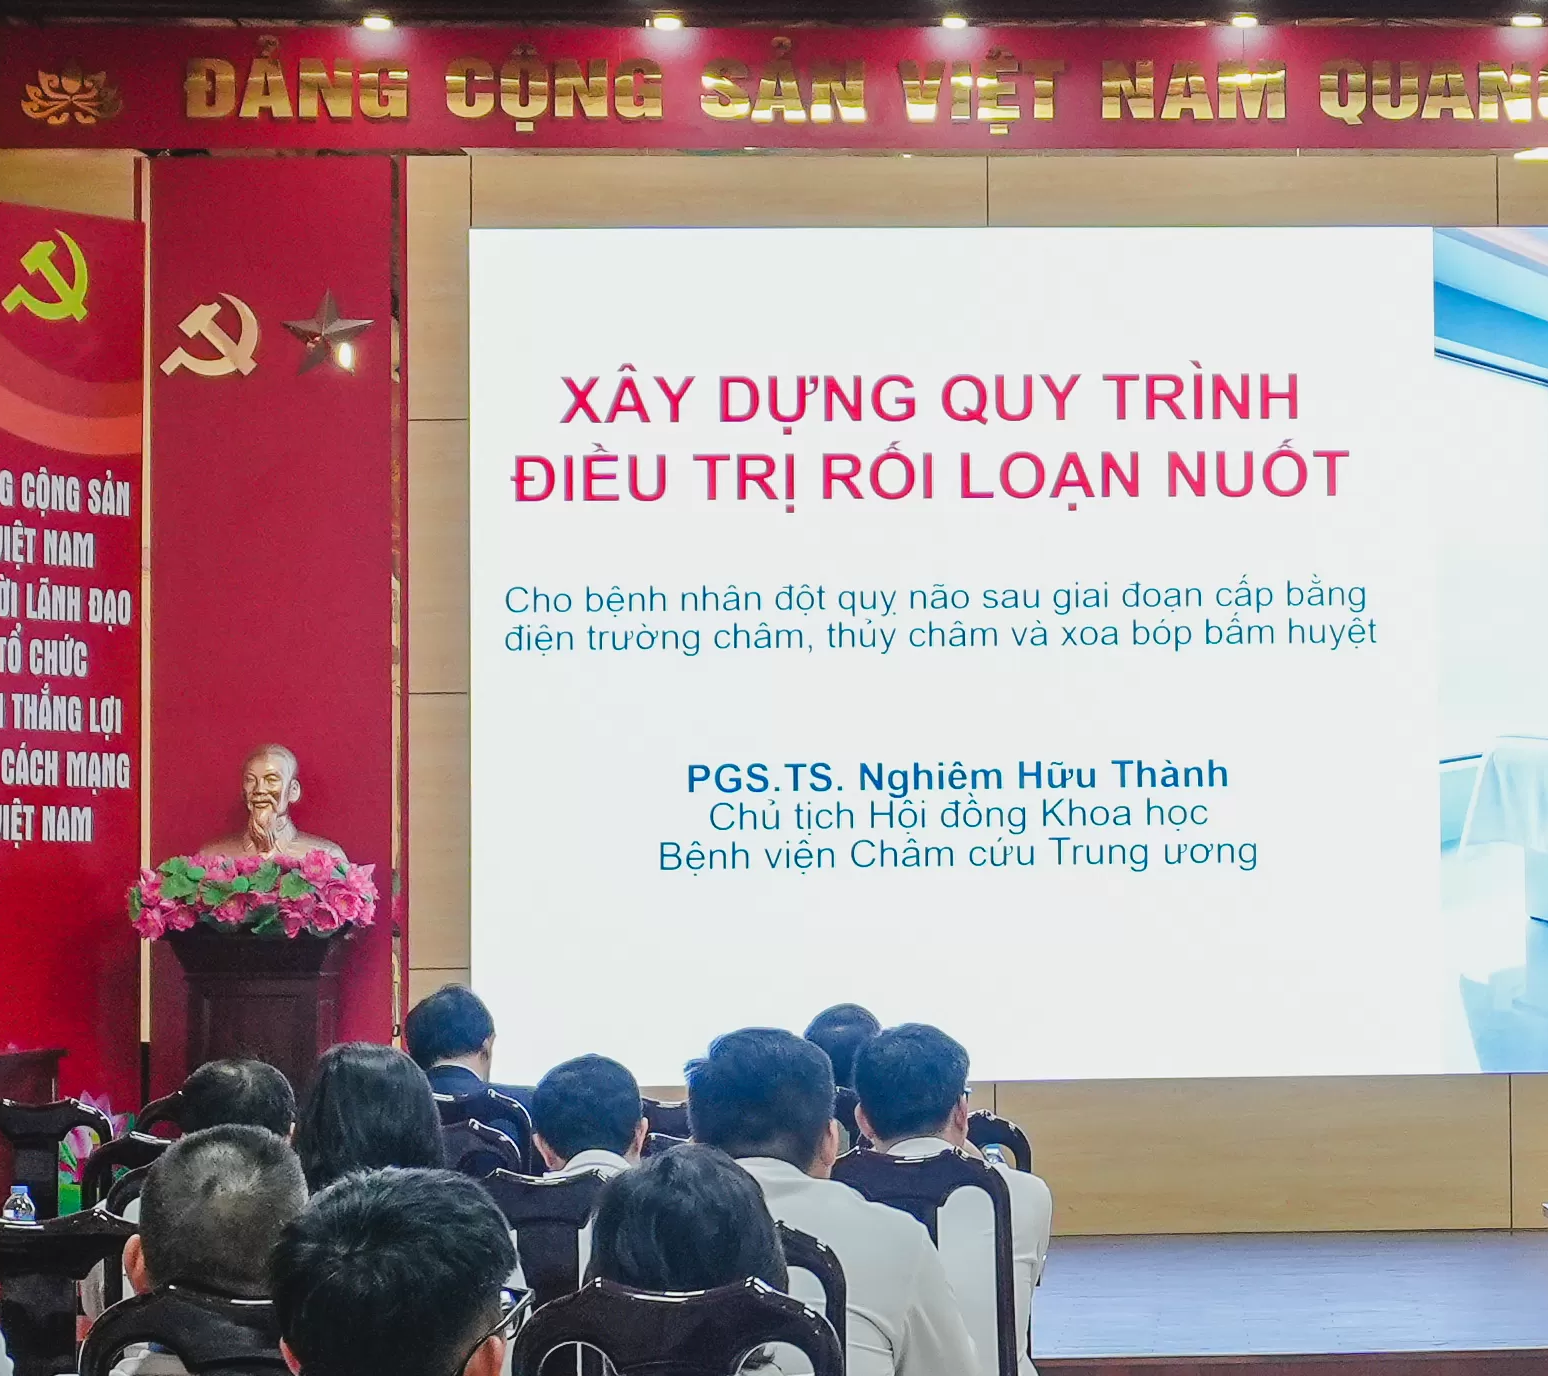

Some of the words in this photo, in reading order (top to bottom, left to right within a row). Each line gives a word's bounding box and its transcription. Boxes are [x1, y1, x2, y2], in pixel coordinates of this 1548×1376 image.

[183, 36, 410, 122] ĐẢNG
[444, 43, 664, 133] CỘNG
[700, 36, 868, 123] SẢN
[898, 44, 1066, 135] VIỆT
[1101, 59, 1288, 121] NAM
[560, 364, 695, 423] XÂY
[720, 375, 915, 435] DỰNG
[942, 375, 1080, 425] QUY
[1103, 361, 1297, 420] TRÌNH
[22, 467, 80, 516] CỘNG
[88, 470, 129, 516] SẢN
[511, 443, 666, 501] ĐIỀU
[693, 454, 794, 513] TRỊ
[823, 441, 932, 500] RỐI
[961, 452, 1139, 511] LOẠN
[1168, 439, 1349, 497] NUỐT
[44, 530, 93, 568] NAM
[27, 578, 80, 621] LÃNH
[88, 588, 130, 631] ĐẠO
[506, 587, 572, 613] Cho
[586, 586, 666, 617] bệnh
[682, 585, 761, 611] nhân
[776, 584, 826, 616] đột
[839, 591, 896, 616] quỵ
[910, 584, 969, 609] não
[983, 590, 1039, 608] sau
[1053, 582, 1108, 615] giai
[1123, 582, 1201, 612] đoạn
[1216, 574, 1273, 612] cấp
[1287, 574, 1365, 612] bằng
[30, 634, 87, 677] CHỨC
[505, 624, 573, 656] điện
[587, 624, 699, 656] trường
[714, 622, 812, 653] châm,
[827, 619, 896, 654] thủy
[910, 621, 997, 647] châm
[1012, 620, 1047, 646] và
[1062, 626, 1118, 646] xoa
[1133, 619, 1192, 652] bóp
[1206, 612, 1274, 644] bấm
[1289, 617, 1376, 650] huyệt
[12, 683, 81, 731] THẮNG
[90, 696, 121, 740] LỢI
[2, 742, 58, 786] CÁCH
[67, 752, 130, 795] MẠNG
[688, 762, 843, 793] PGS.TS.
[860, 761, 1002, 798] Nghiêm
[1019, 761, 1095, 789] Hữu
[1111, 759, 1228, 788] Thành
[43, 806, 91, 841] NAM
[710, 799, 779, 830] Chủ
[795, 801, 854, 835] tịch
[871, 800, 925, 834] Hội
[941, 792, 1026, 835] đồng
[1043, 799, 1131, 826] Khoa
[1147, 798, 1207, 831] học
[660, 841, 749, 876] Bệnh
[765, 840, 834, 874] viện
[851, 838, 953, 868] Châm
[969, 837, 1034, 866] cứu
[1048, 837, 1148, 872] Trung
[1165, 843, 1256, 871] ương
